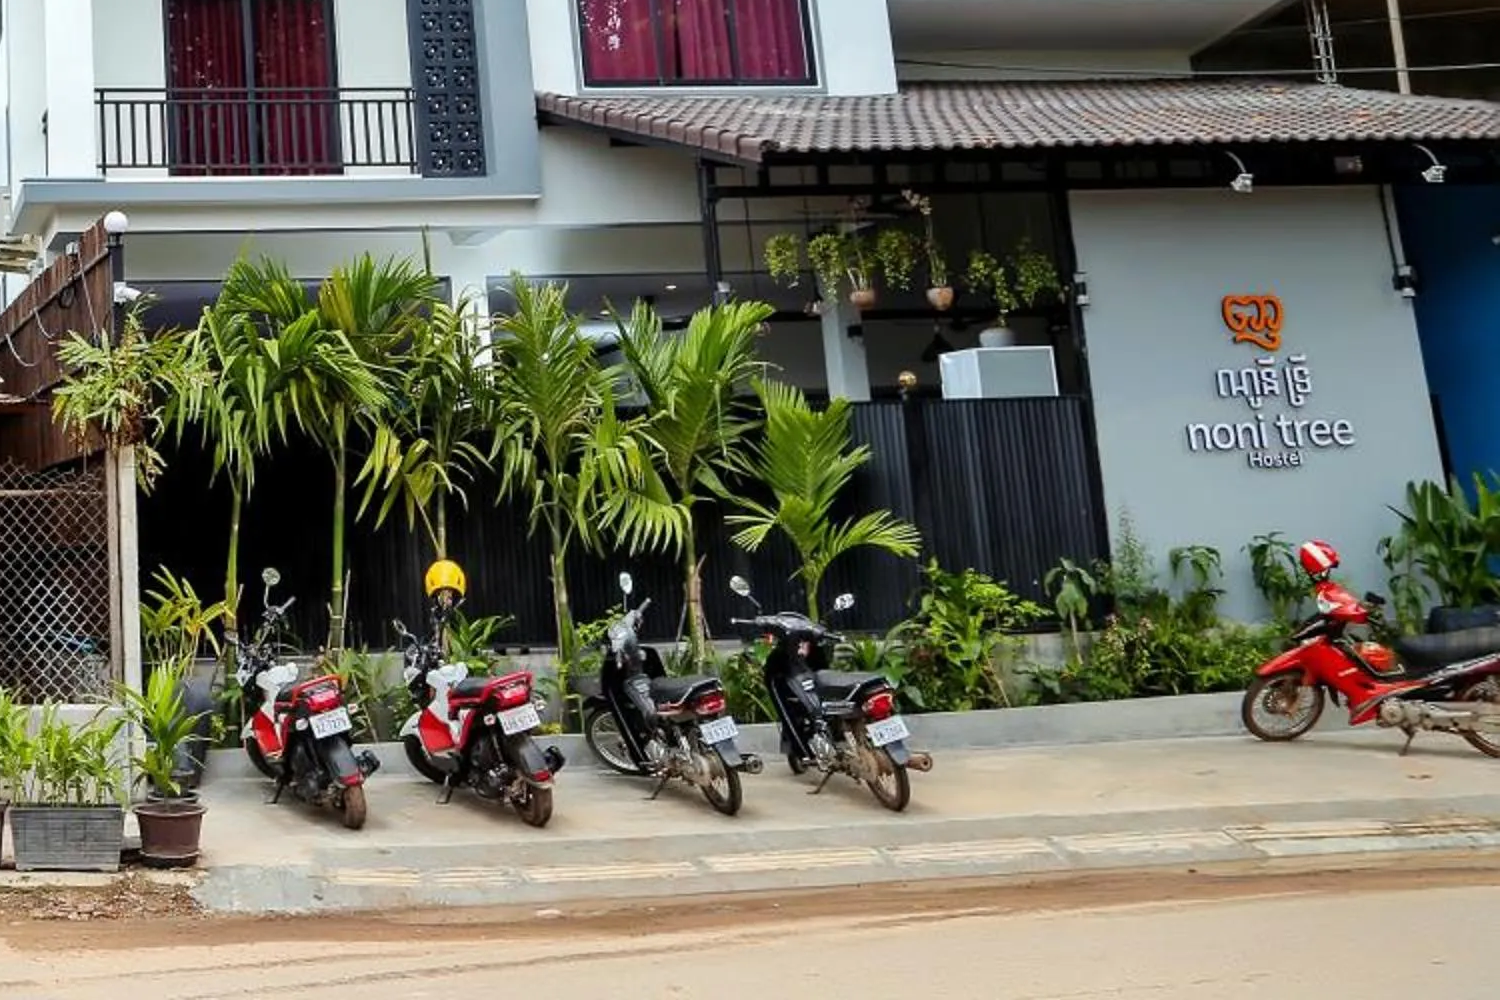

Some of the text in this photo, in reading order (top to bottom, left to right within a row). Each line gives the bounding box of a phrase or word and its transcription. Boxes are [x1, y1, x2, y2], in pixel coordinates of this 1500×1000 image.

[1186, 413, 1356, 450] noni tree
[1249, 452, 1303, 468] Hostel
